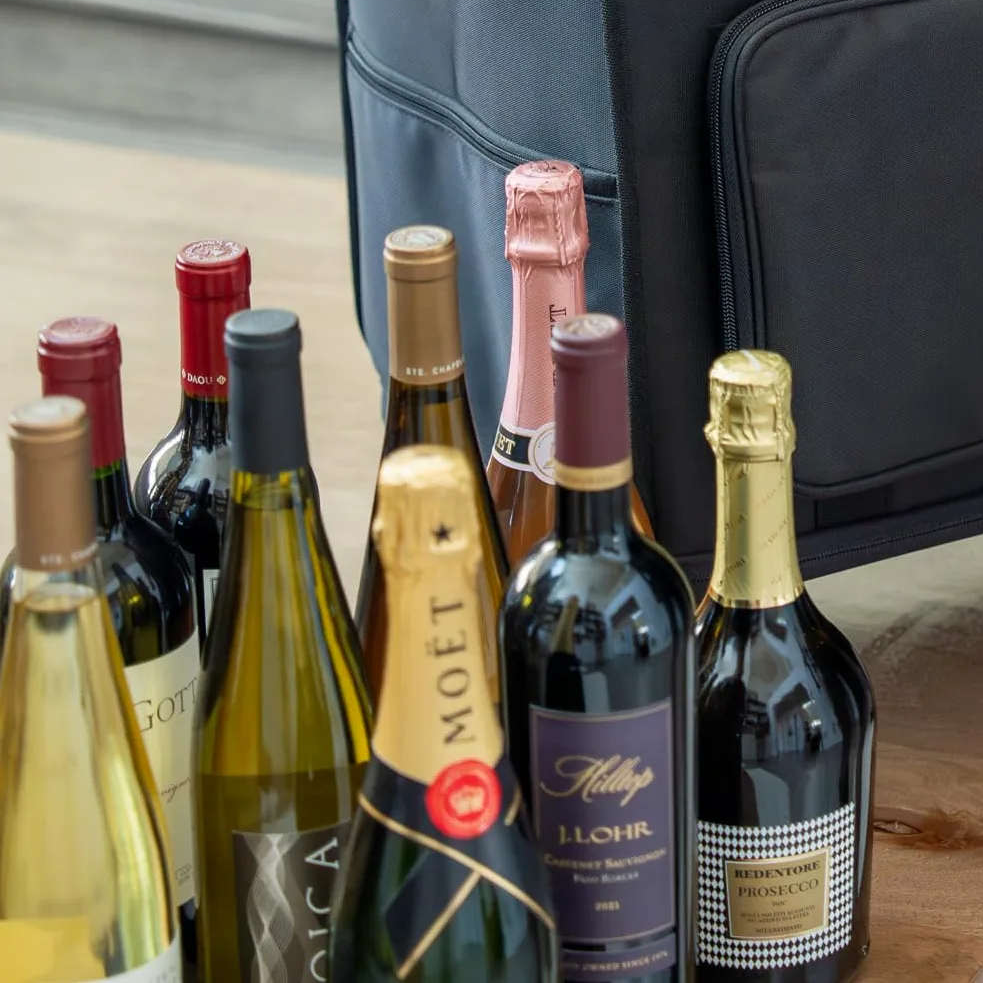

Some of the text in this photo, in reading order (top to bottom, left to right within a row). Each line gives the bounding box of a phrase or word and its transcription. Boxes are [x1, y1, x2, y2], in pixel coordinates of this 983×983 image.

[187, 373, 213, 385] DAOU
[427, 596, 476, 744] MOËT
[734, 860, 820, 879] REDENTORE
[738, 878, 819, 898] PROSECCO
